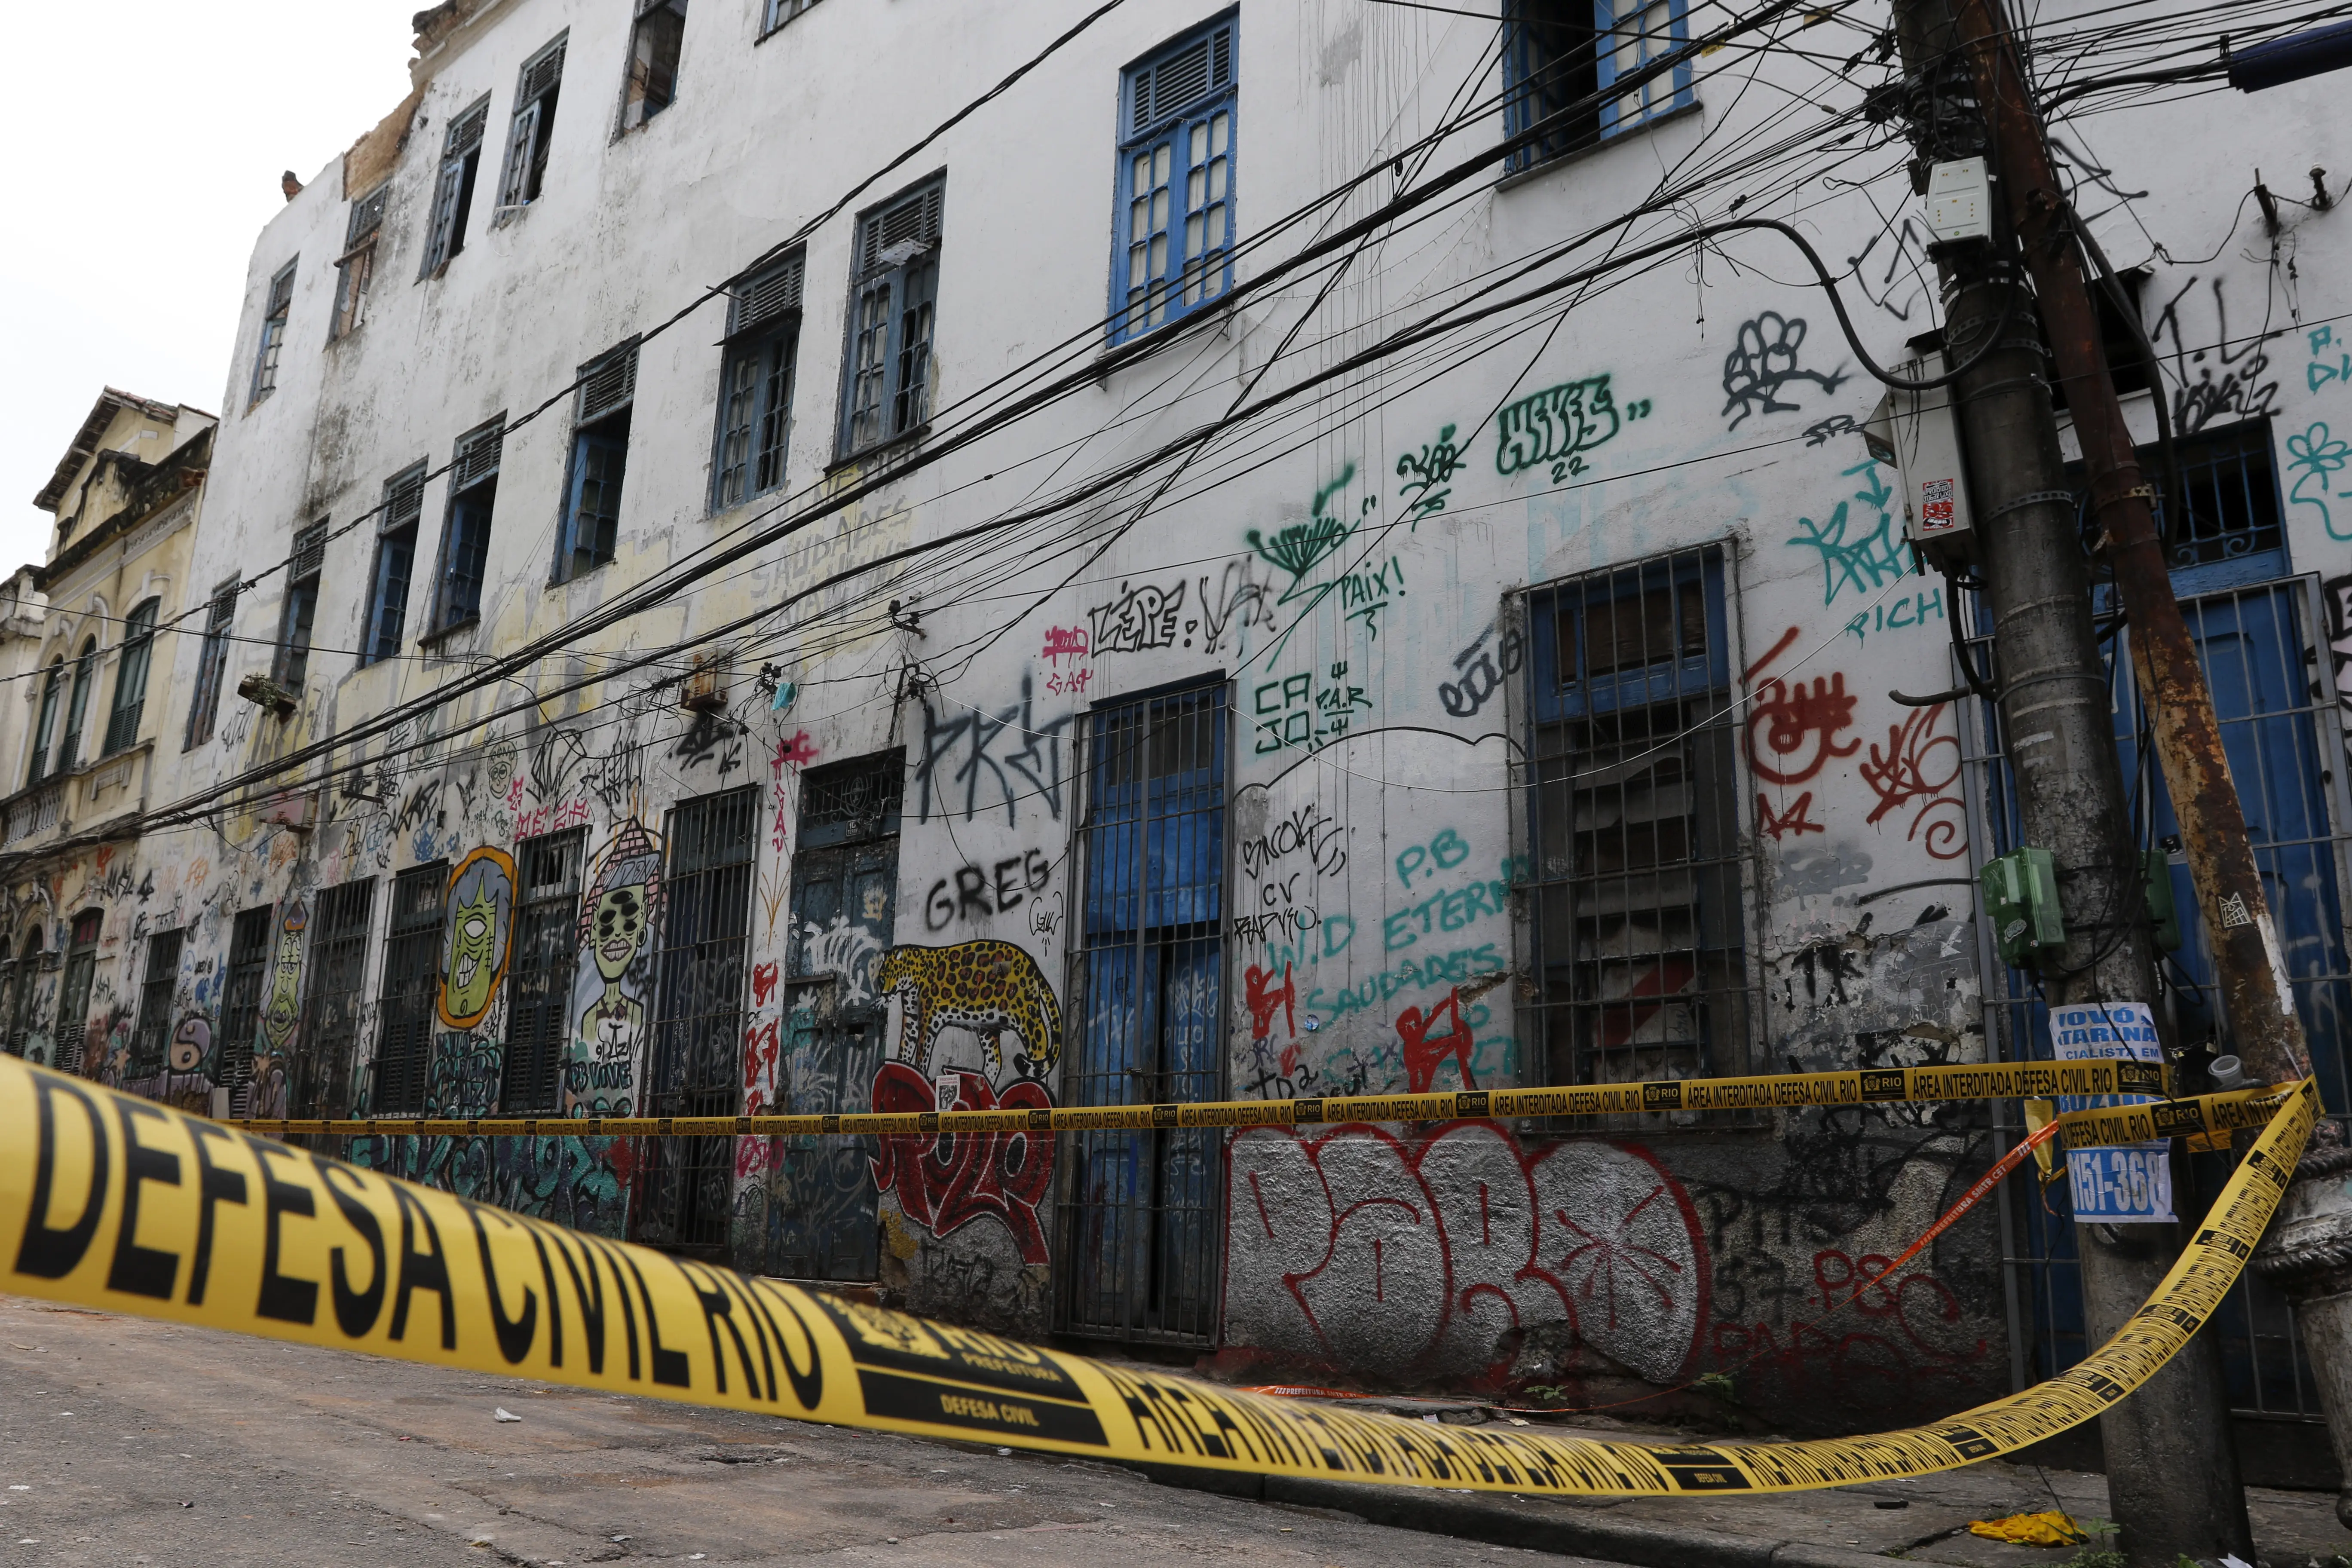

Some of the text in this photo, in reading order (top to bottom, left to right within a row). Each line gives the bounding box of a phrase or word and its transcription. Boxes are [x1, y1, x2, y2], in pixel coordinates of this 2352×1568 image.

[925, 850, 1050, 932] GREG
[2064, 1047, 2159, 1060] CIALISTA EM
[589, 1060, 633, 1090] VIVE
[1882, 1077, 1902, 1087] RIO
[1943, 1071, 2014, 1098] INTERDITADA
[2015, 1069, 2060, 1095] DEFESA
[2061, 1069, 2090, 1095] CIVIL
[2092, 1068, 2113, 1093] RIO
[1472, 1097, 1486, 1106] RIO
[1517, 1094, 1569, 1116] INTERDITADA
[1569, 1092, 1602, 1114] DEFESA
[1602, 1091, 1625, 1112] CIVIL
[1625, 1090, 1640, 1111] RIO
[1661, 1088, 1678, 1098] RIO
[1713, 1084, 1773, 1108] INTERDITADA
[1774, 1081, 1809, 1106] DEFESA
[1813, 1080, 1839, 1104] CIVIL
[1840, 1078, 1857, 1102] RIO
[1068, 1112, 1103, 1129] INTERDITADA
[1103, 1112, 1125, 1128] DEFESA
[1125, 1111, 1139, 1128] CIVIL
[1140, 1110, 1151, 1128] RIO
[1198, 1108, 1237, 1126] INTERDITADA
[1237, 1106, 1263, 1125] DEFESA
[1263, 1106, 1280, 1124] CIVIL
[1280, 1105, 1292, 1124] RIO
[1308, 1104, 1320, 1113] RIO
[1346, 1102, 1391, 1121] INTERDITADA
[1391, 1100, 1418, 1120] DEFESA
[1420, 1099, 1439, 1119] CIVIL
[1440, 1098, 1453, 1118] RIO
[2176, 1108, 2199, 1121] RIO
[2211, 1096, 2246, 1130] ÁREA
[2100, 1116, 2130, 1144] CIVIL
[2129, 1113, 2151, 1140] RIO
[1971, 1177, 1994, 1199] SMTR
[1992, 1164, 2007, 1179] CET
[14, 1068, 824, 1411] DEFESA CIVIL RIO
[960, 1351, 1063, 1383] PREFEITURA
[940, 1393, 1040, 1427] DEFESA CIVIL
